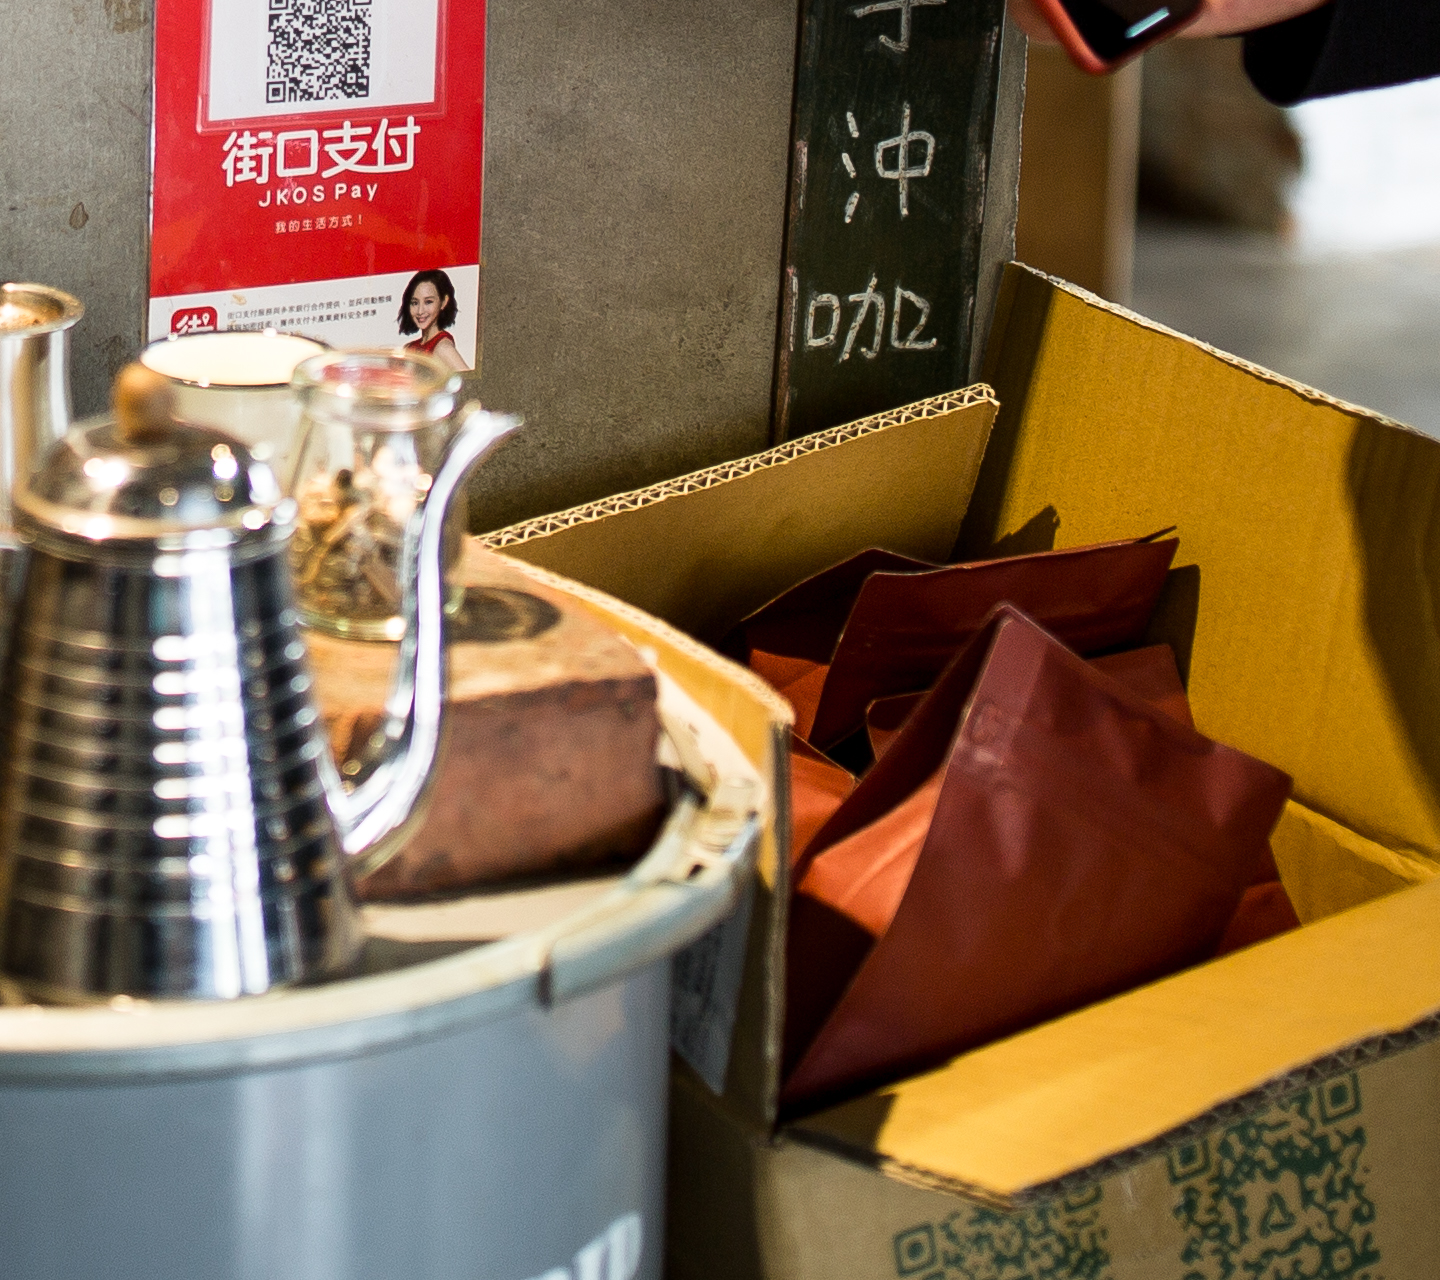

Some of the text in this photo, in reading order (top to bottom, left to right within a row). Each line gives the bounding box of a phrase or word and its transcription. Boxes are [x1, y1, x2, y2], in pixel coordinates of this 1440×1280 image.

[221, 115, 422, 188] 街口支付
[258, 183, 378, 208] JKOS Pay
